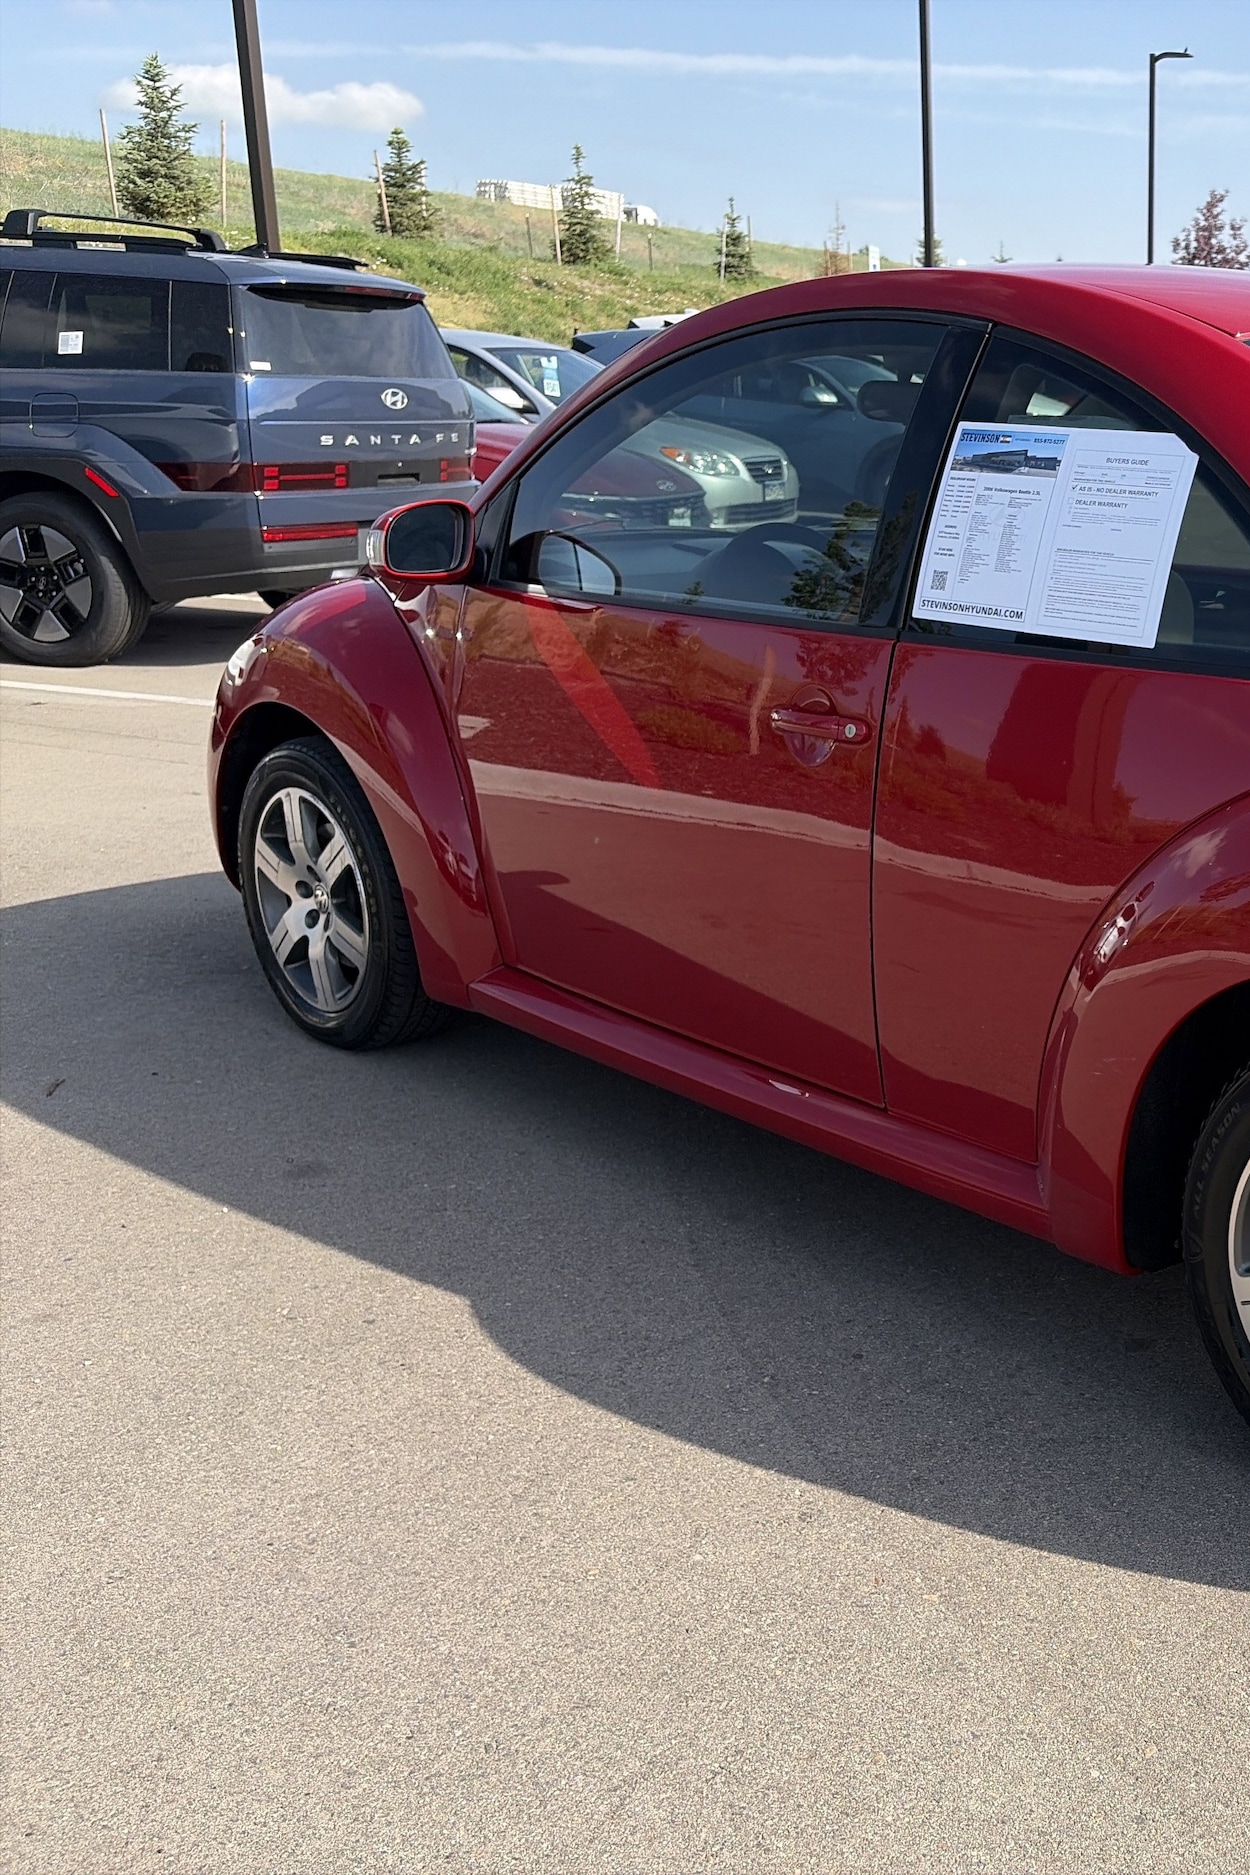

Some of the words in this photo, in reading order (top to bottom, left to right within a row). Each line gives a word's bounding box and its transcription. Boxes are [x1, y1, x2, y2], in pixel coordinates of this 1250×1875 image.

[320, 434, 421, 446] SANTA
[436, 433, 459, 443] FE
[960, 432, 1000, 443] STEVINSON
[1106, 457, 1130, 465] BUYERS
[921, 599, 1024, 619] STEVINSONHYUNDAI.COM
